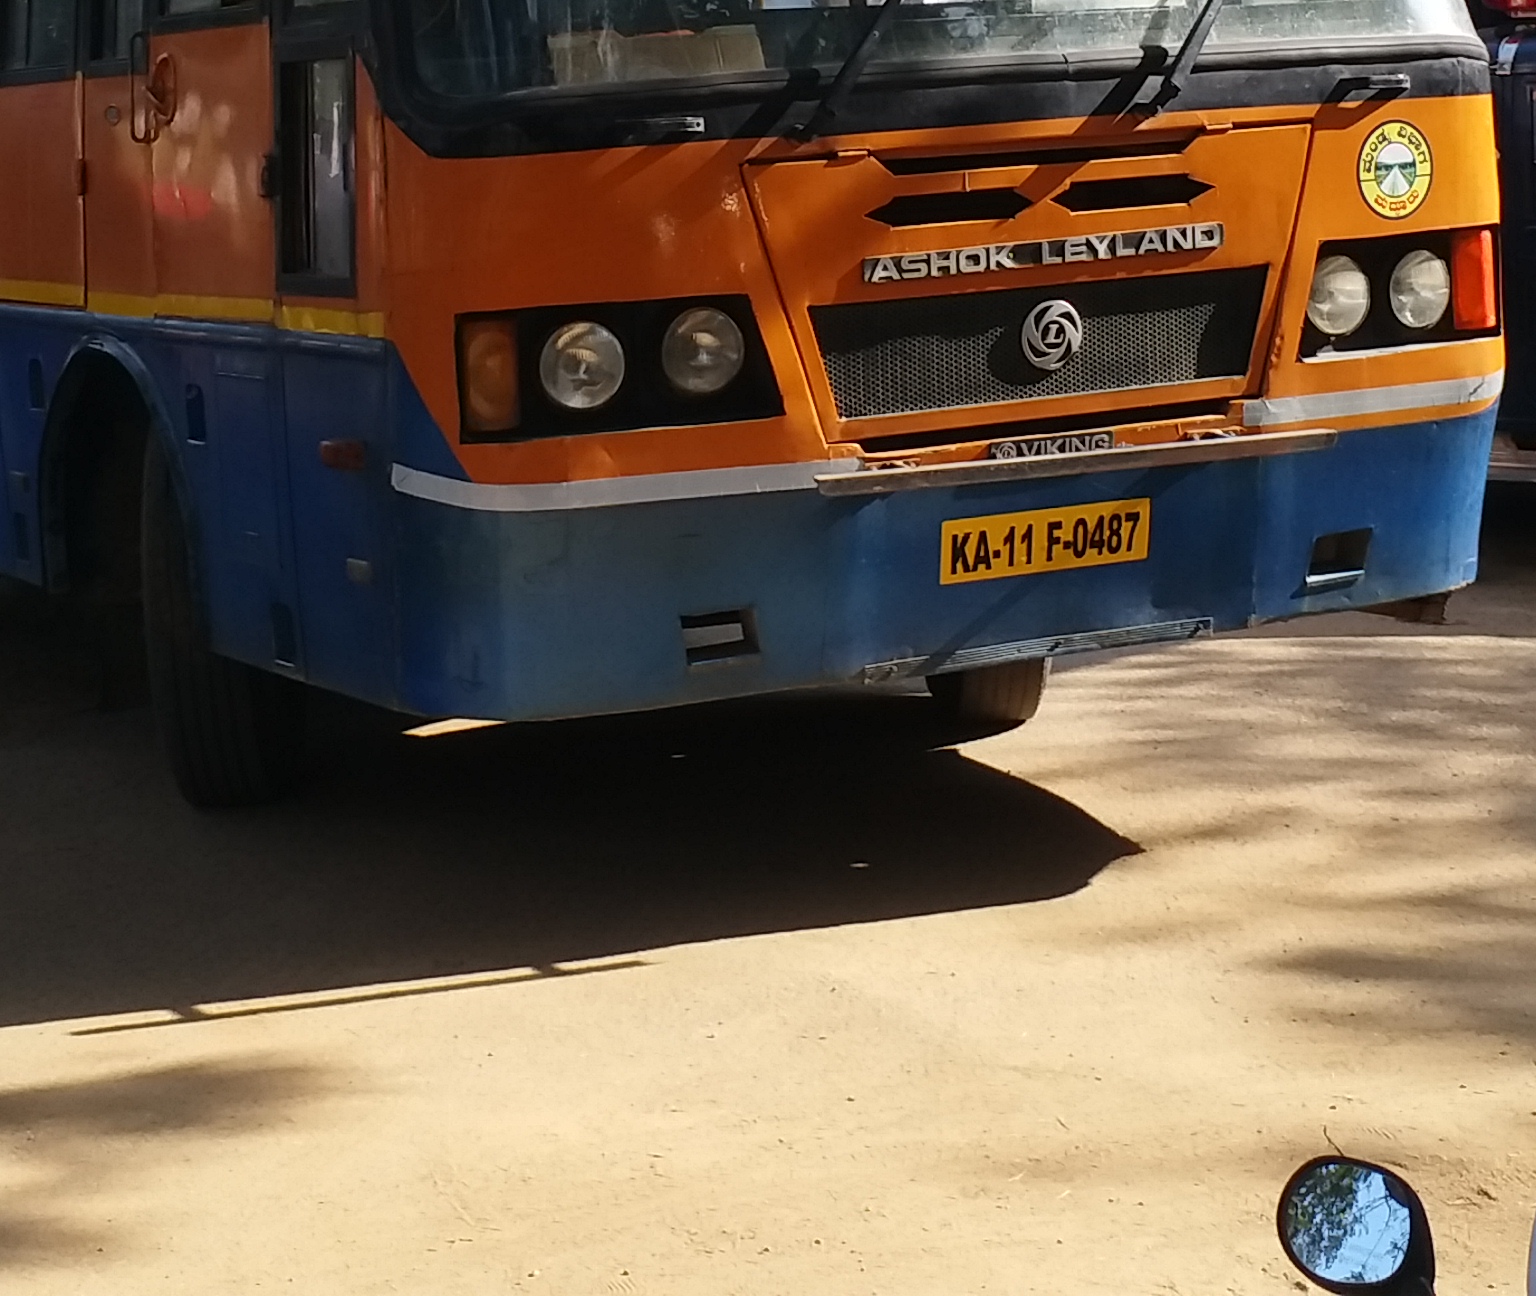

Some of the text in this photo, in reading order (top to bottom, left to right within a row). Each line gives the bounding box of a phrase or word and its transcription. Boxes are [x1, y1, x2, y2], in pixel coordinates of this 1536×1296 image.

[1396, 125, 1429, 165] ವಿಭಾಗ
[867, 223, 1224, 283] ASHOK LEYLAND
[1016, 433, 1111, 456] VIKING
[949, 510, 1142, 577] KA-11 F-0487
